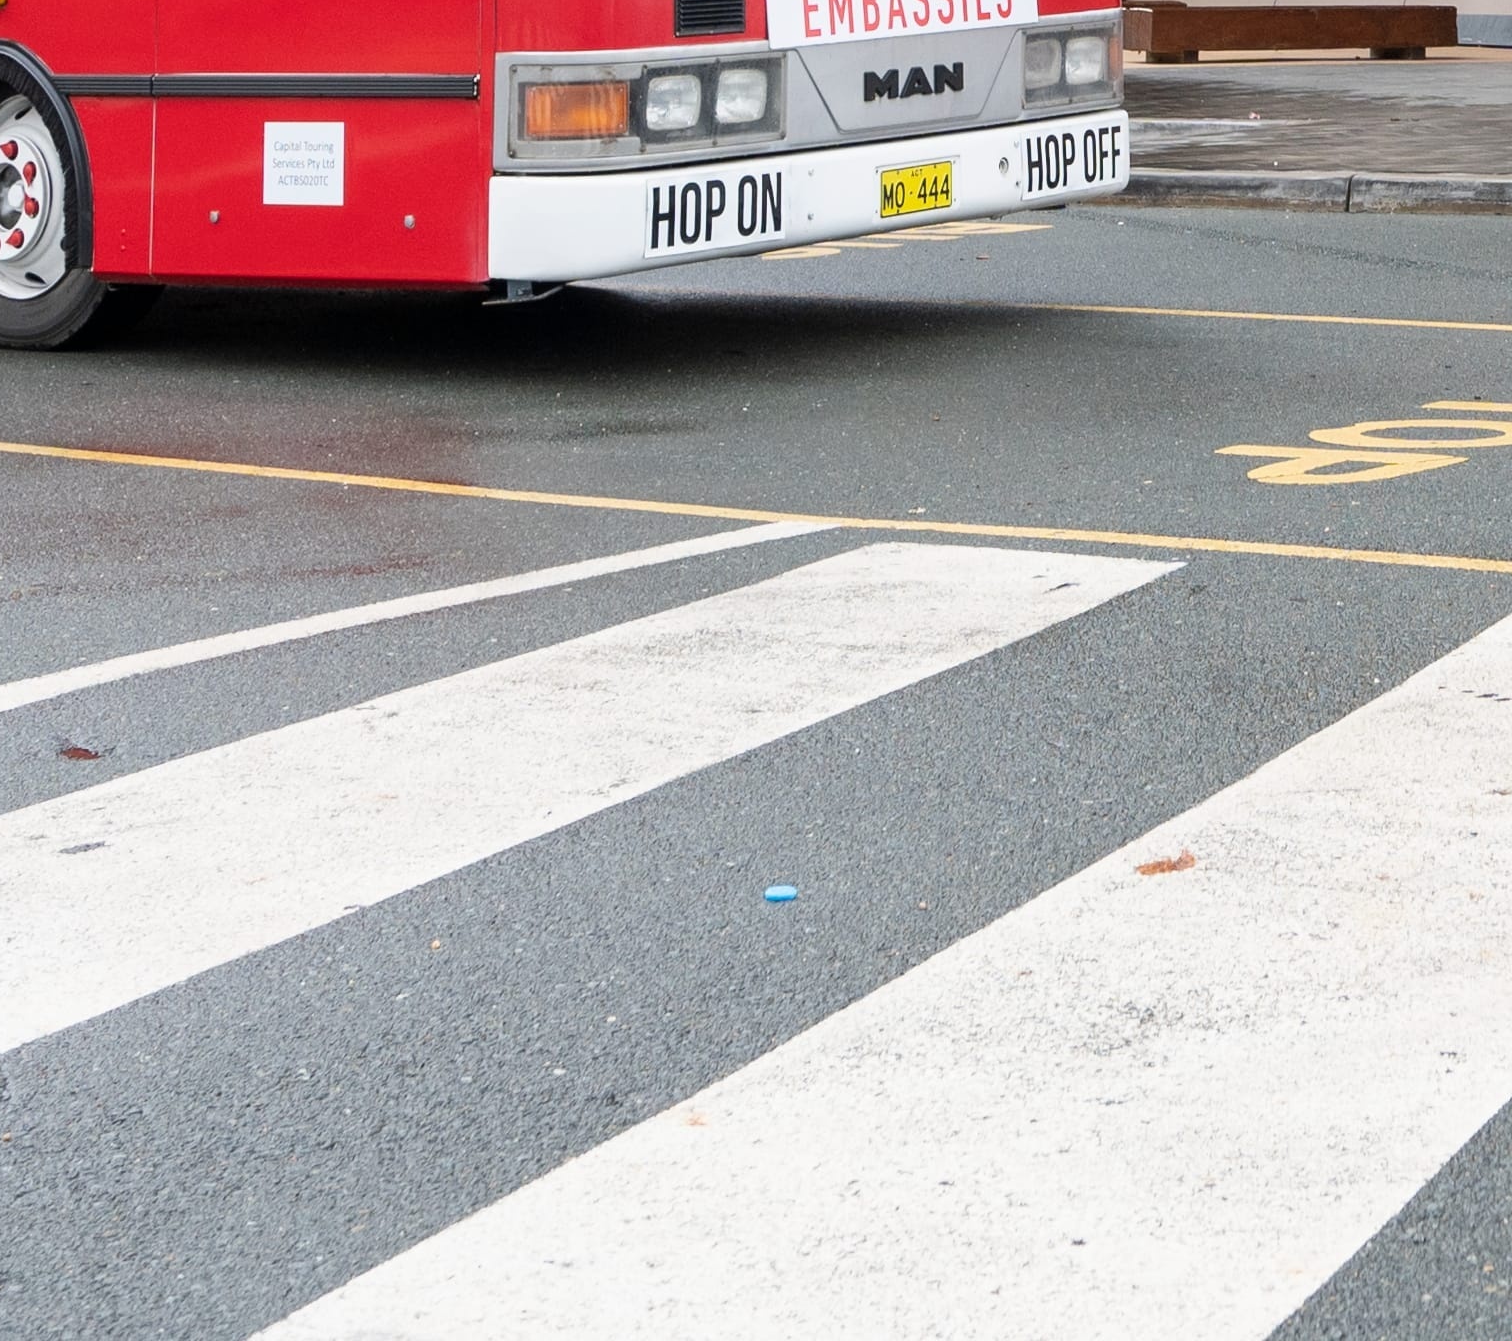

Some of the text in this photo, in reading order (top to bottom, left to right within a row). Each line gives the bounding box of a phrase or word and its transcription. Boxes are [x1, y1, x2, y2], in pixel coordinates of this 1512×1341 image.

[864, 62, 964, 102] MAN
[274, 140, 334, 154] Capital Touring
[1026, 126, 1121, 192] HOP OFF
[273, 157, 335, 170] Services Pty Ltd
[910, 168, 923, 177] ACT
[651, 179, 726, 249] HOP
[738, 172, 782, 236] ON
